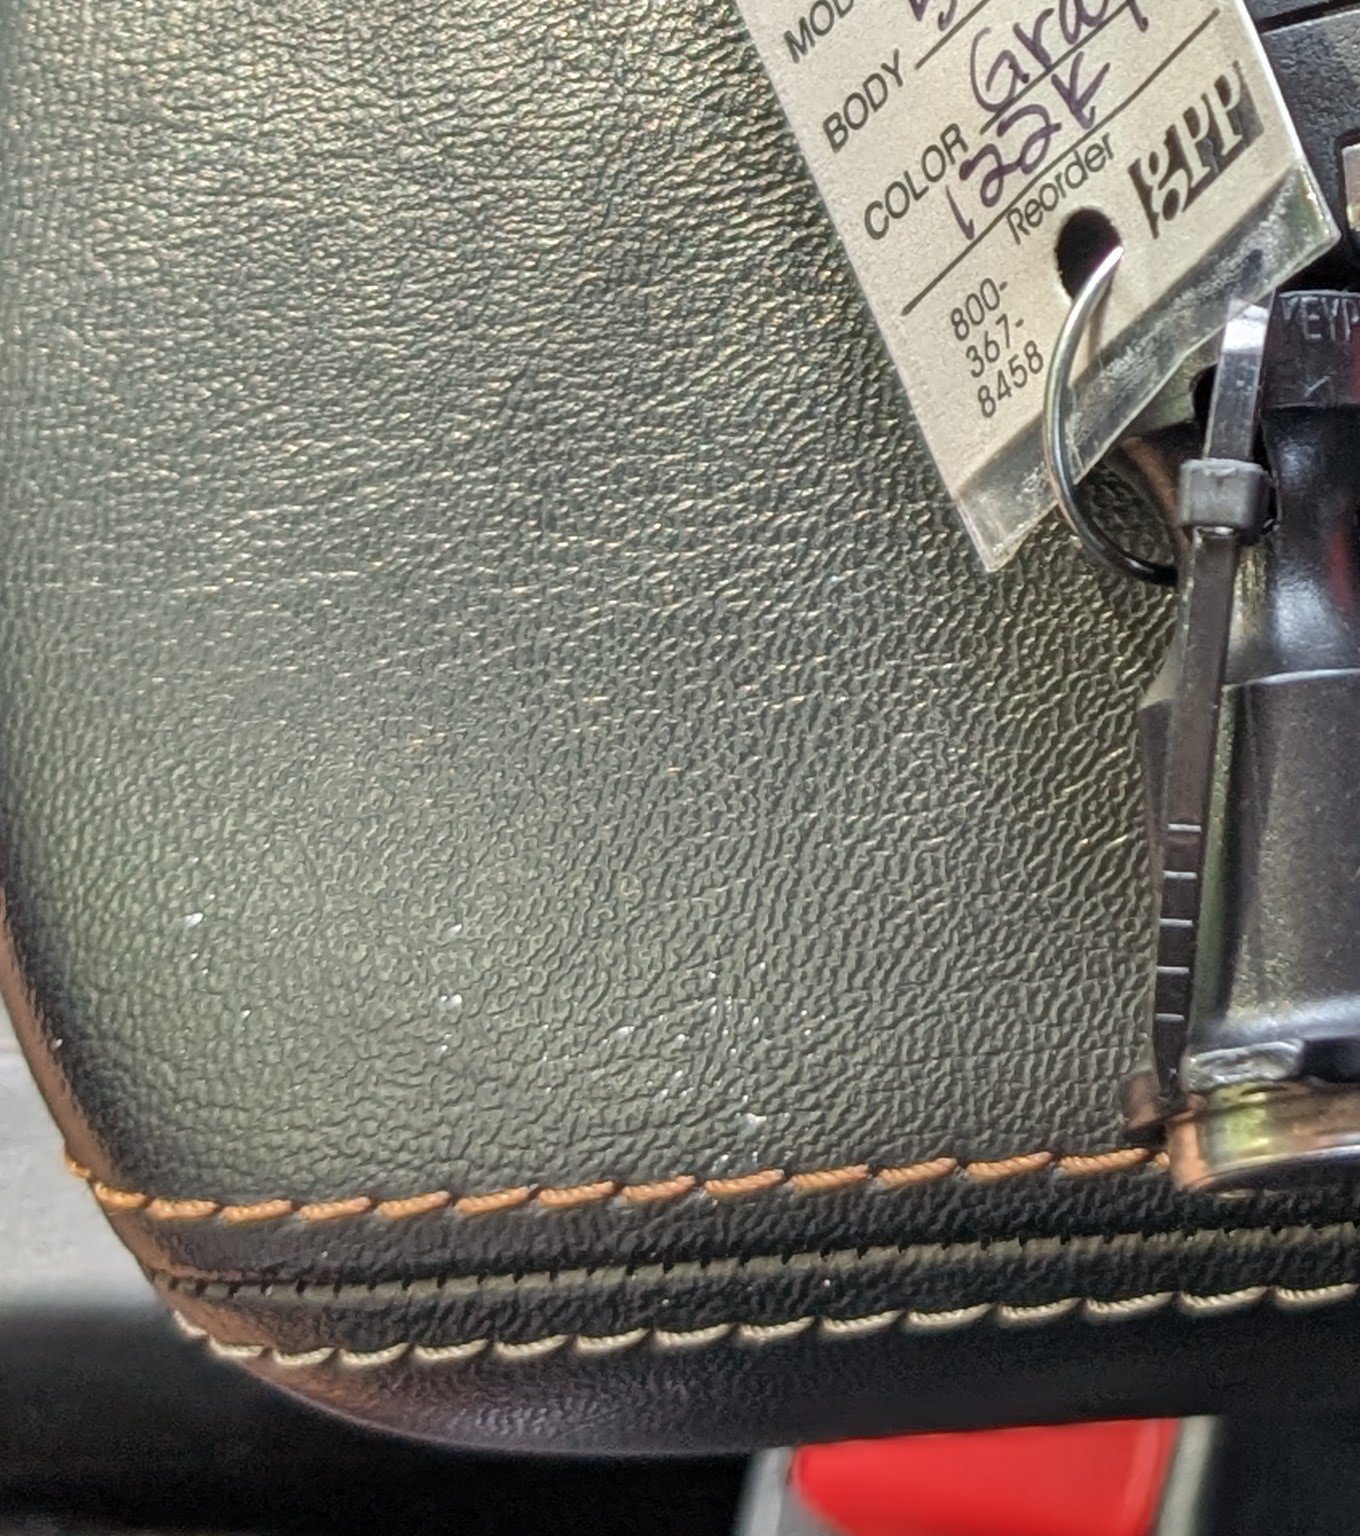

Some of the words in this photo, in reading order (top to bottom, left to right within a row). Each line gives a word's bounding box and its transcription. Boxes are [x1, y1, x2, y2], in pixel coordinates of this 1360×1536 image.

[821, 50, 906, 153] BODY
[864, 123, 968, 241] COLOR
[1007, 133, 1117, 244] Reorder
[950, 279, 1009, 343] 800-
[965, 318, 1026, 378] 367-
[976, 340, 1045, 418] 8458
